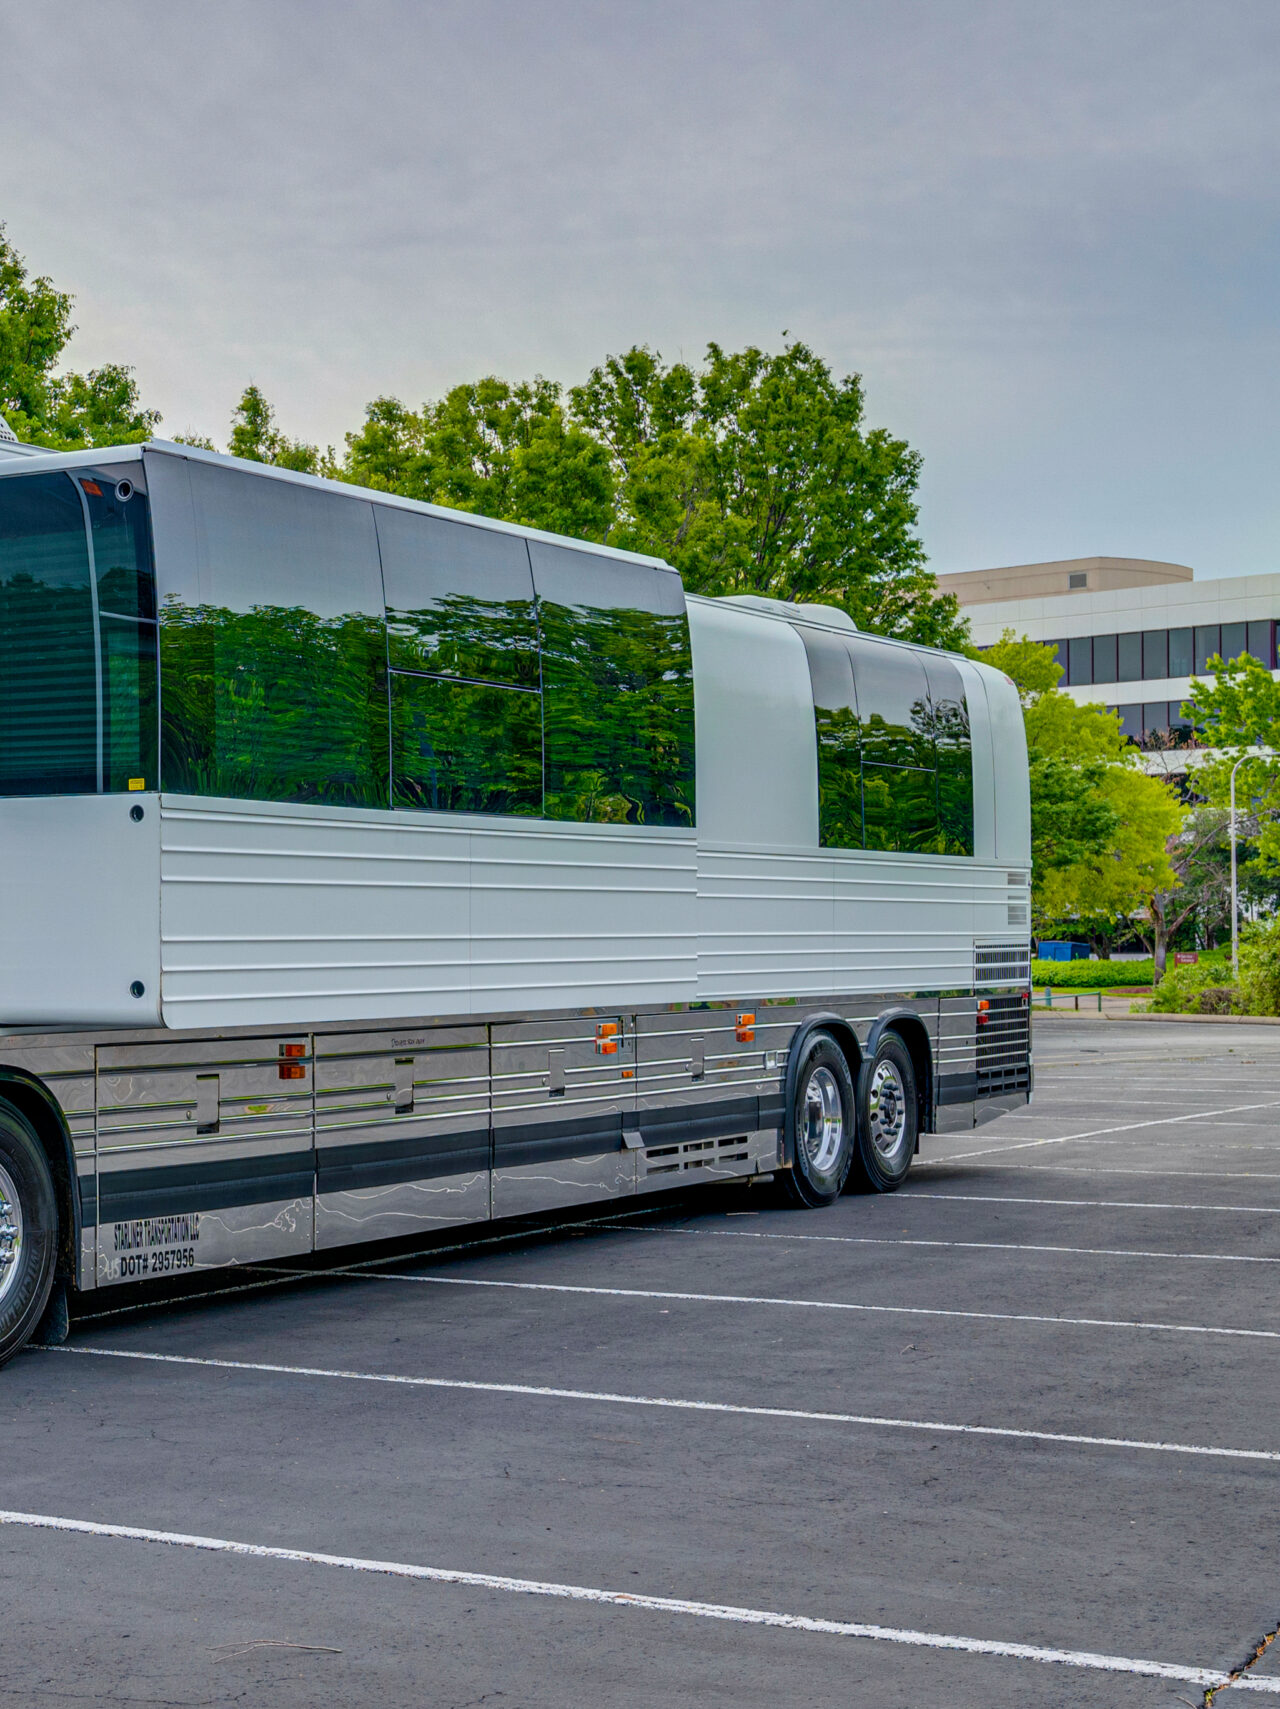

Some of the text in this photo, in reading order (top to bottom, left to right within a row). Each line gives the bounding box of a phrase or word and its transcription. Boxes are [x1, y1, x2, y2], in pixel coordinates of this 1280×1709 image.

[114, 1213, 200, 1251] STARLINER TRANSPORTATION LLC
[121, 1252, 148, 1277] DOT#
[151, 1247, 195, 1272] 2957956
